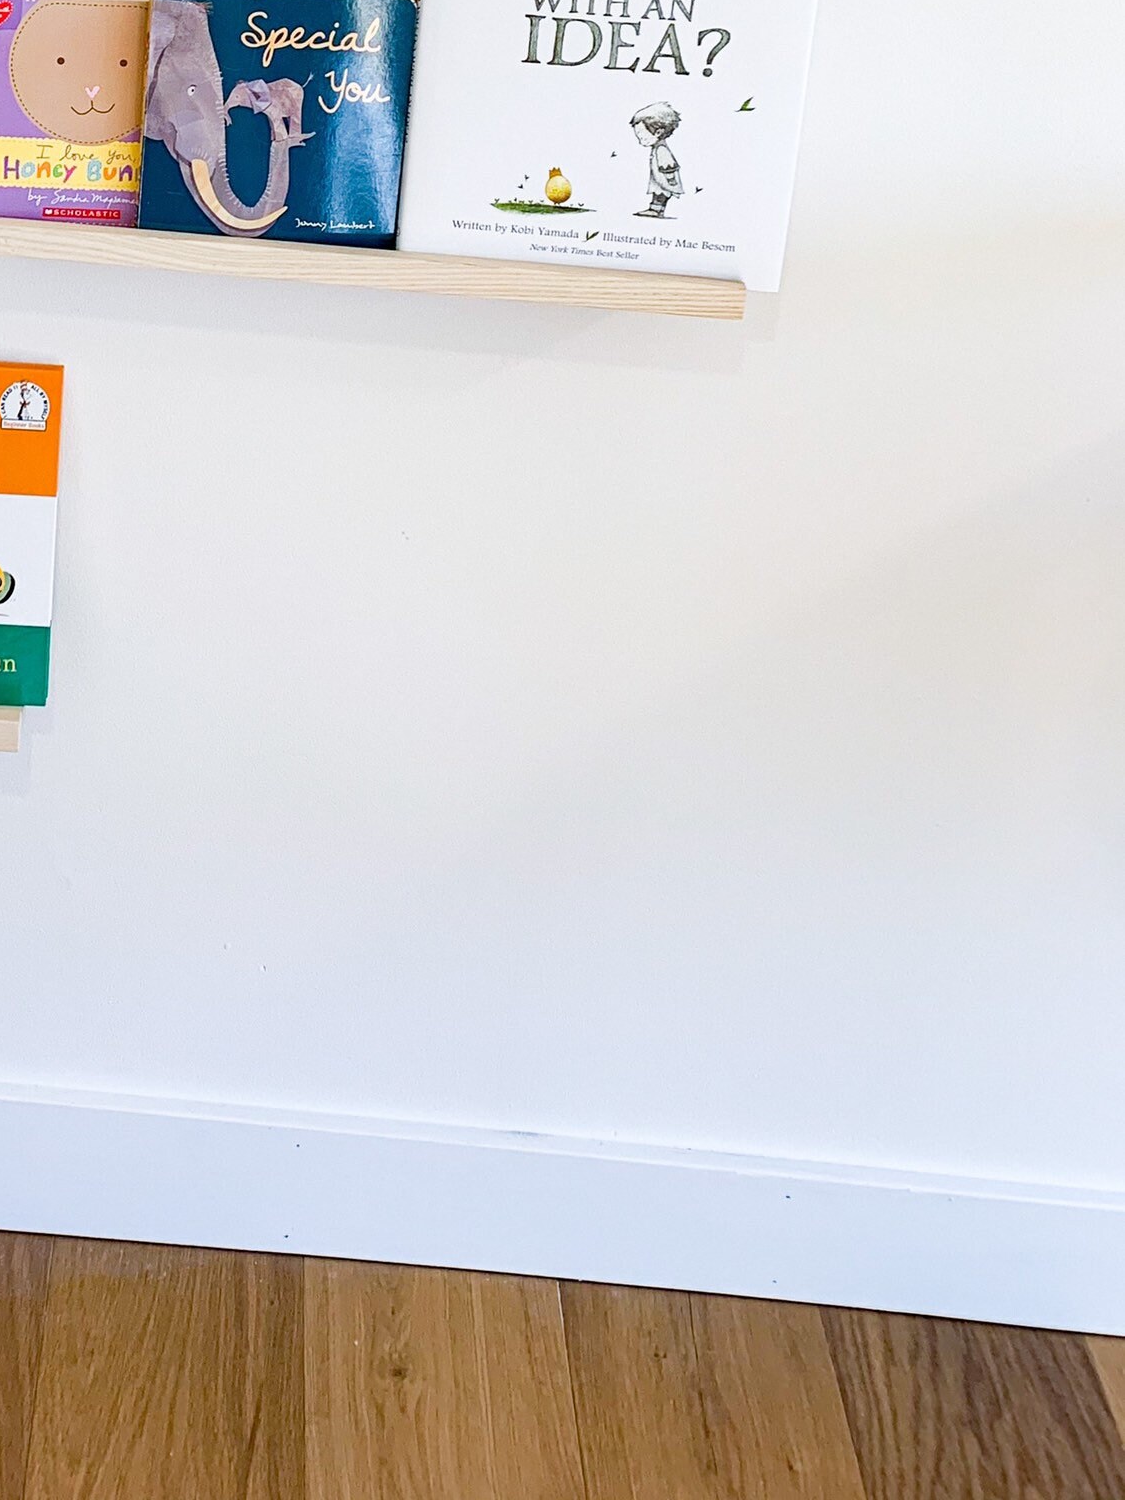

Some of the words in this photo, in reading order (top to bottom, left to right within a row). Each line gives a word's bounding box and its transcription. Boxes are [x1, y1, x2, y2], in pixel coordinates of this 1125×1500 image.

[241, 11, 382, 69] Special
[521, 14, 732, 78] IDEA?
[36, 144, 53, 159] I
[59, 144, 97, 161] love
[3, 156, 77, 183] Honey
[87, 159, 138, 182] Bun
[27, 188, 47, 206] by
[51, 188, 90, 205] Sandra
[53, 208, 119, 218] SCHOLASTIC
[451, 219, 492, 232] Written
[495, 223, 508, 234] by
[510, 224, 535, 235] Kobi
[538, 226, 579, 239] Yamada
[602, 232, 657, 246] Illustrated
[659, 237, 673, 249] by
[675, 238, 699, 249] Mae
[701, 240, 736, 252] Besom
[529, 243, 548, 252] New
[550, 244, 568, 253] York
[571, 247, 594, 256] Times
[596, 248, 613, 258] Best
[615, 251, 640, 260] Seller
